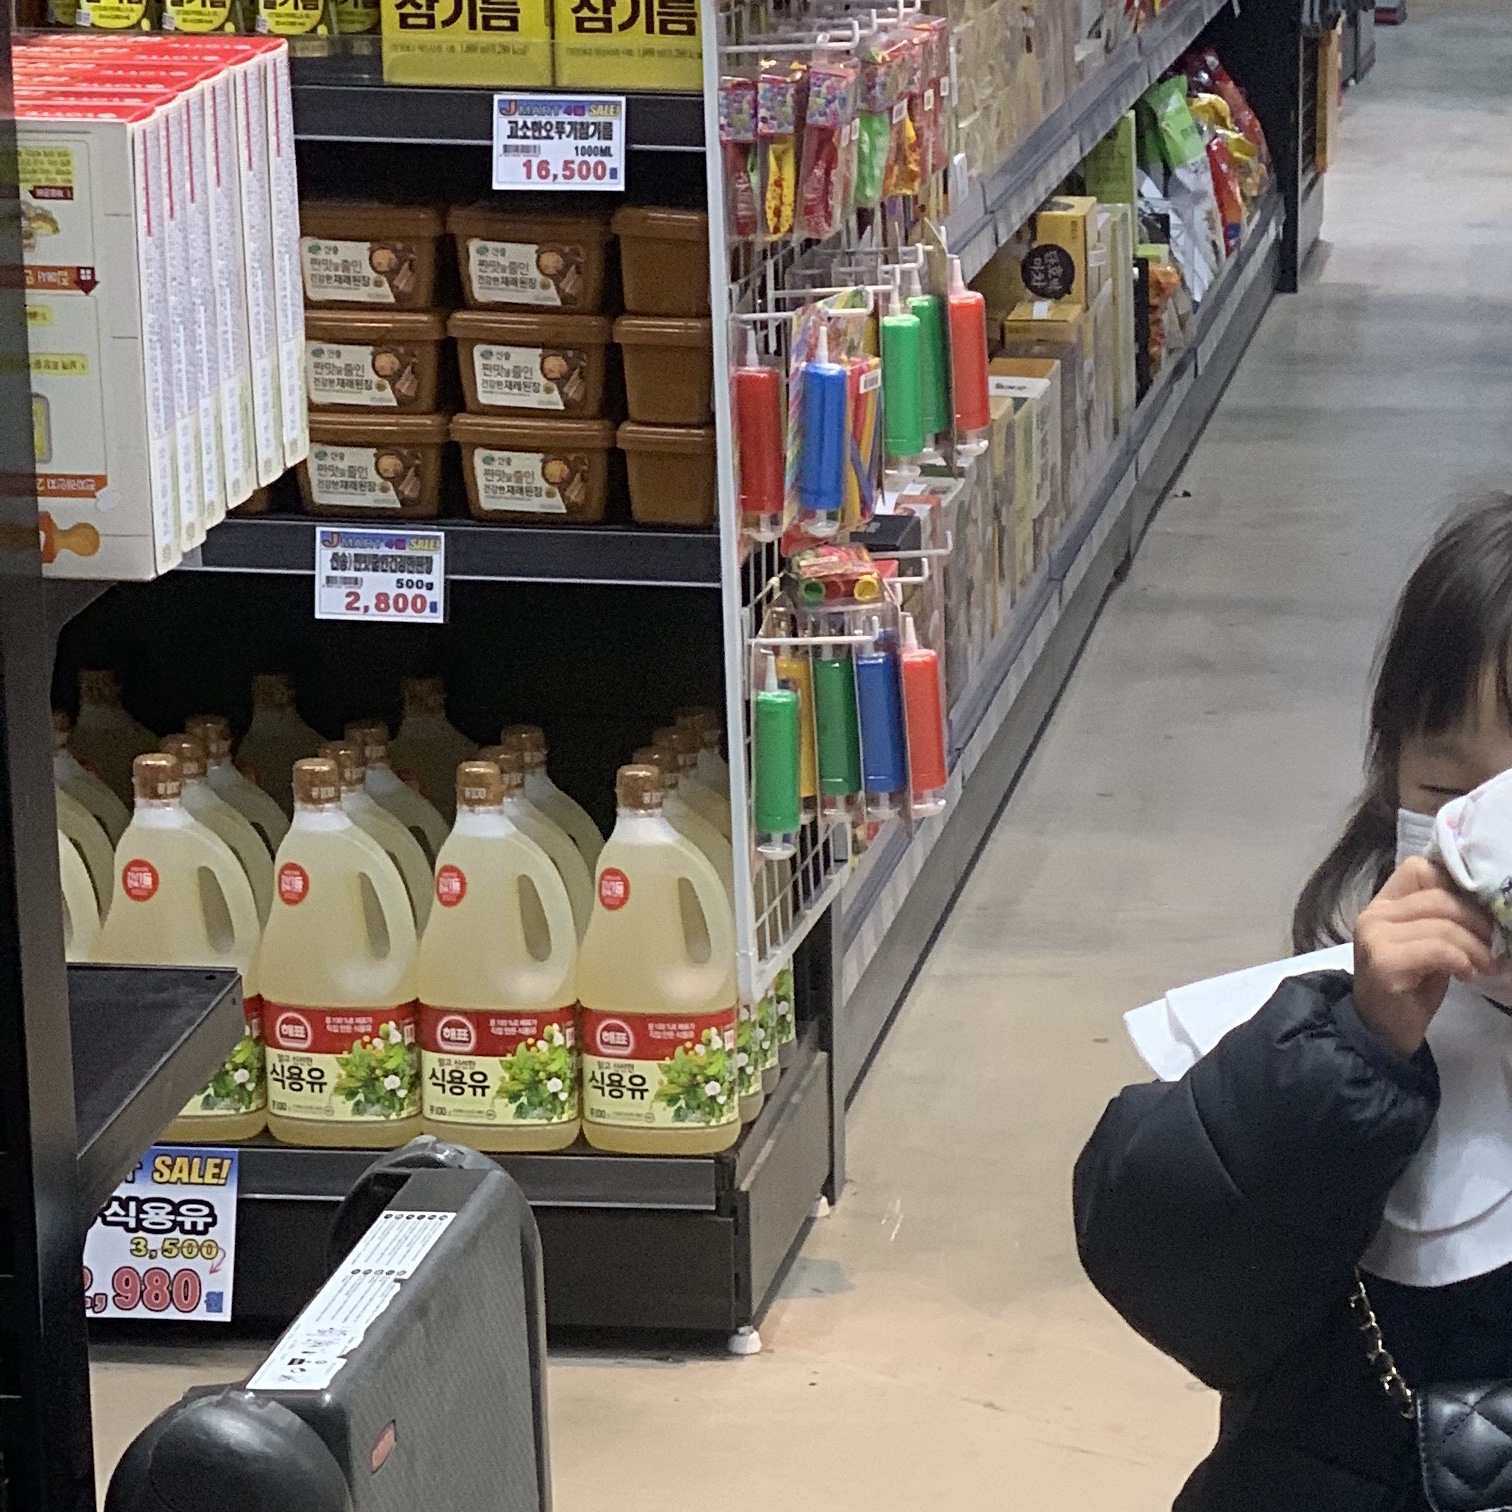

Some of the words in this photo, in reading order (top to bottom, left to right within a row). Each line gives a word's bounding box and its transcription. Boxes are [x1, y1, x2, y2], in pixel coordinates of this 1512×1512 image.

[574, 145, 613, 157] 1000ML
[522, 159, 607, 181] 16,500
[396, 578, 434, 591] 500g
[345, 591, 428, 614] 2,800
[270, 1063, 327, 1093] 식용유
[429, 1068, 490, 1097] 식용유
[589, 1070, 649, 1100] 식용유
[153, 1155, 232, 1185] SALE!
[102, 1197, 216, 1234] 식용유
[130, 1236, 219, 1260] 3,500
[83, 1266, 201, 1313] ,980
